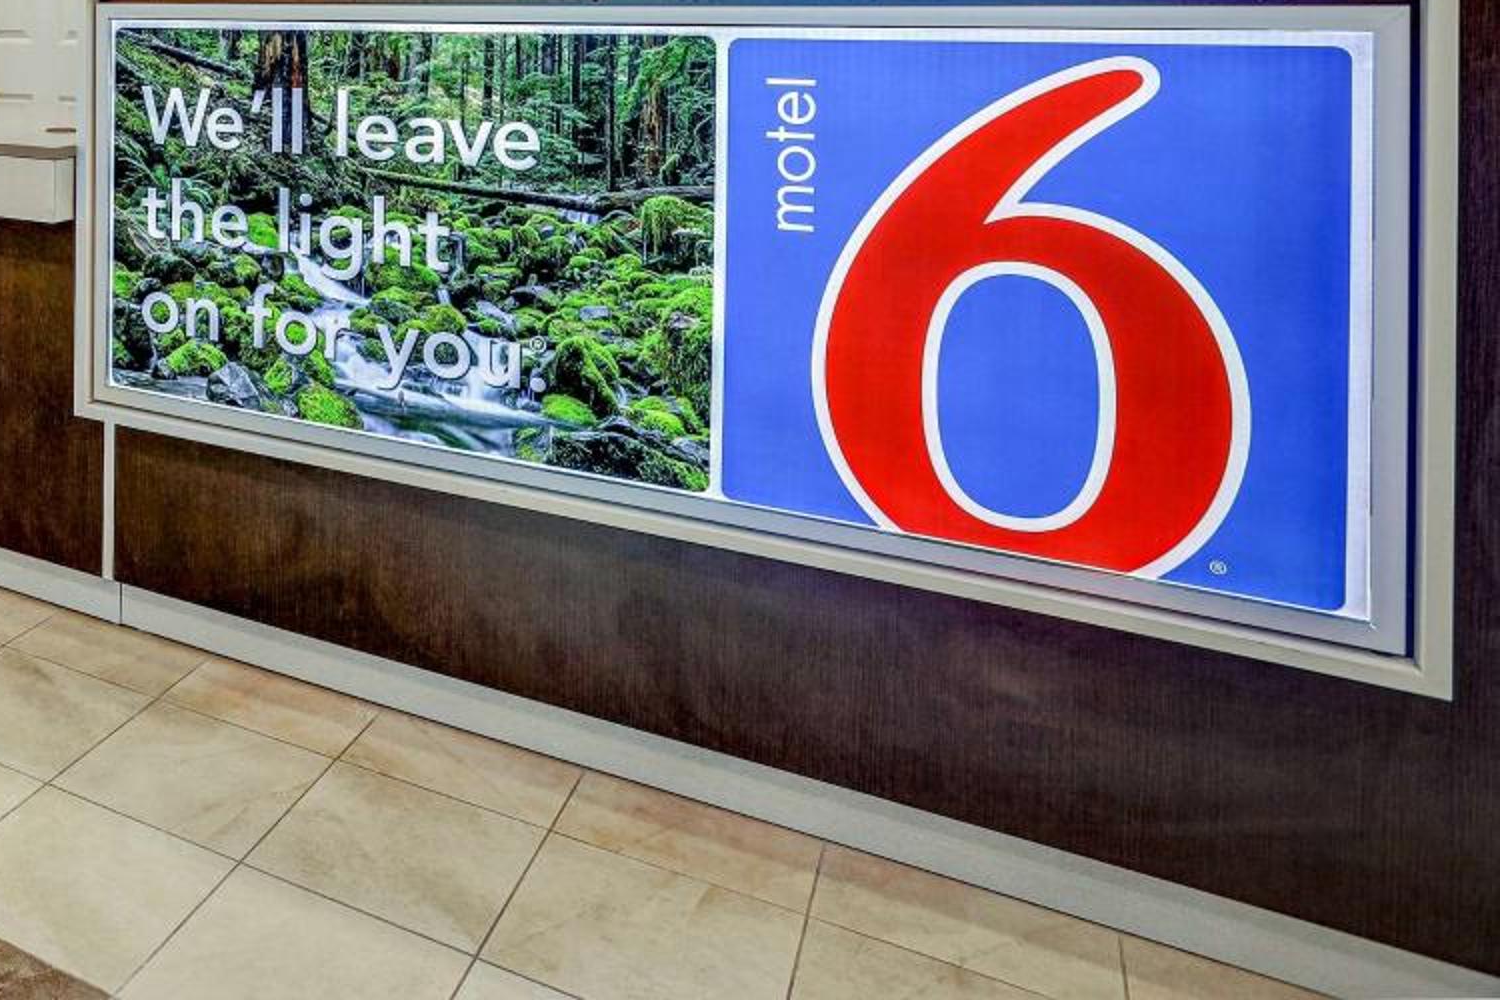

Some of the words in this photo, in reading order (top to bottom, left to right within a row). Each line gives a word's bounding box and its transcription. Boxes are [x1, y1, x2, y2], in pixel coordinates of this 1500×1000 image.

[141, 85, 303, 155] We'll
[336, 87, 542, 172] leave
[765, 77, 817, 232] motel
[142, 177, 249, 250] the
[278, 186, 450, 281] light
[141, 290, 220, 342] on
[246, 284, 355, 361] for
[811, 56, 1252, 580] 6
